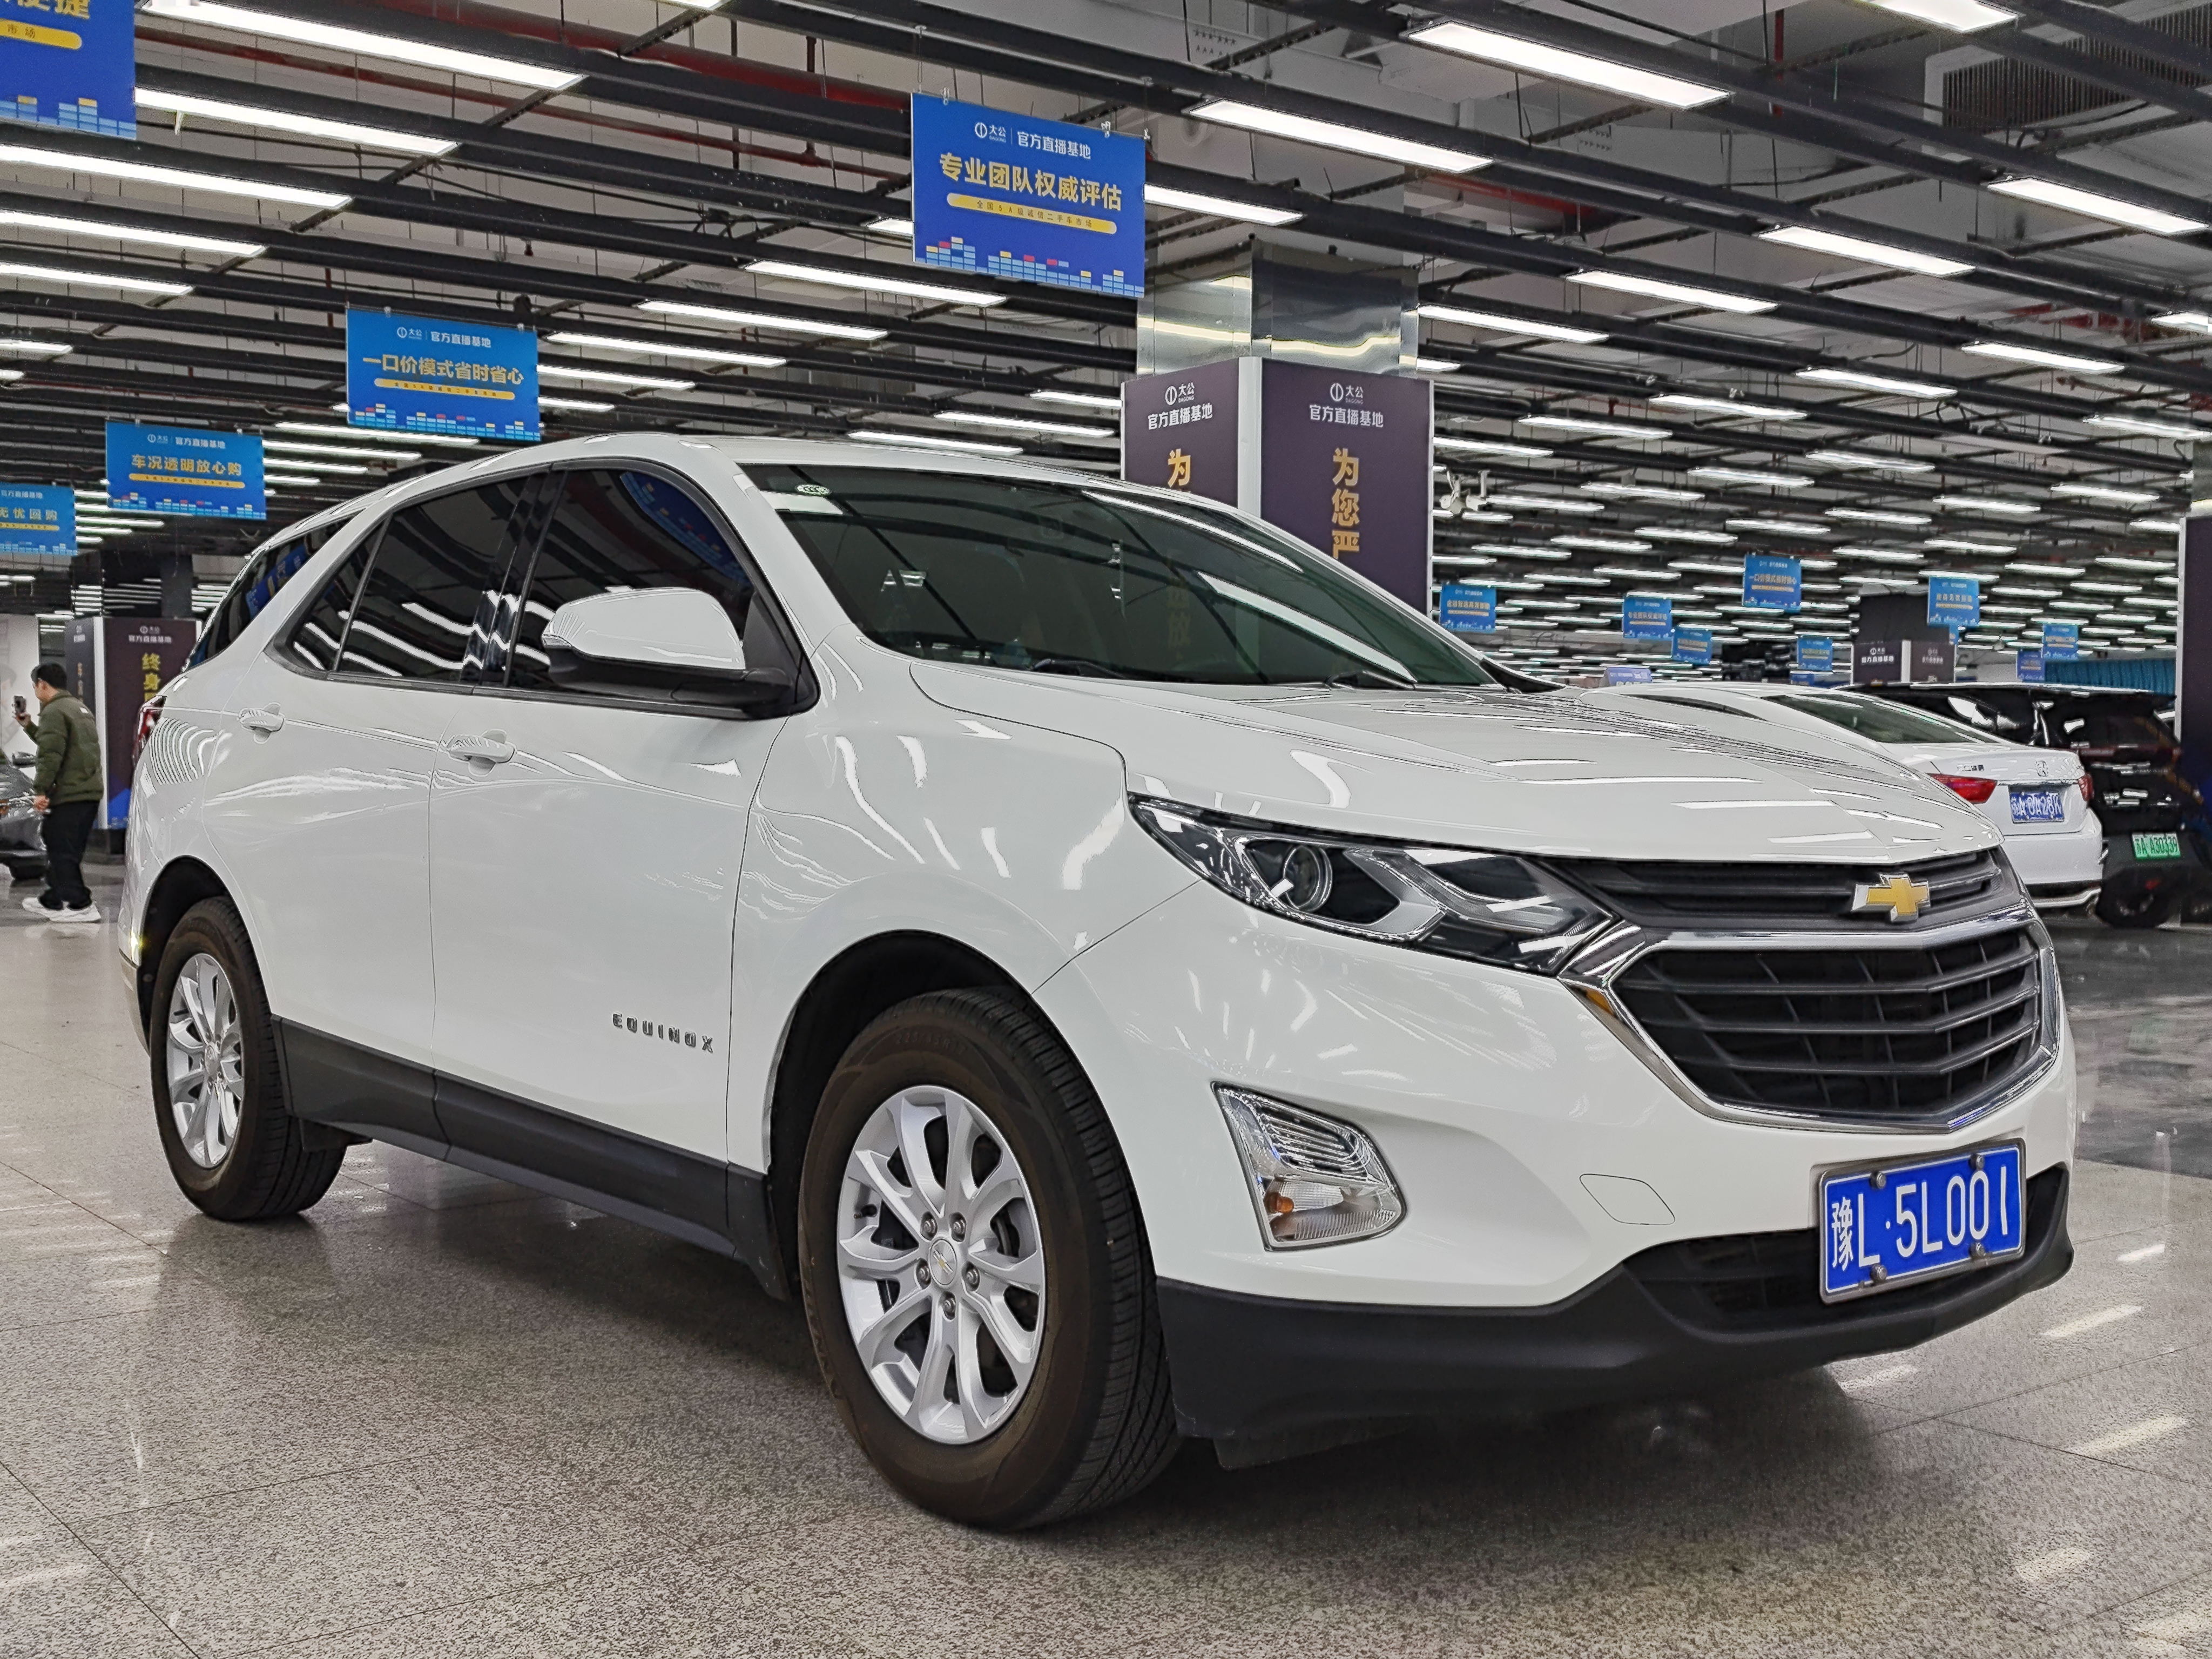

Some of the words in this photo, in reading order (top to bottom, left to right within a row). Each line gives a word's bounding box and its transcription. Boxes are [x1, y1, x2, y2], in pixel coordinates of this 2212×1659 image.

[989, 124, 1006, 137] 大公
[1017, 131, 1091, 160] 官方直播基地
[940, 153, 1122, 211] 专业团队权威评估
[430, 331, 491, 348] 官方直播基地
[363, 354, 524, 385] 一口价模式省时省心
[1178, 382, 1195, 397] 大公
[1346, 385, 1364, 399] 大公
[1148, 402, 1213, 430] 官方直播基地
[1309, 404, 1384, 428] 官方直播基地
[132, 454, 241, 476] 车况透明放心购
[1168, 448, 1191, 493] 为
[612, 1012, 713, 1054] EQUINOX
